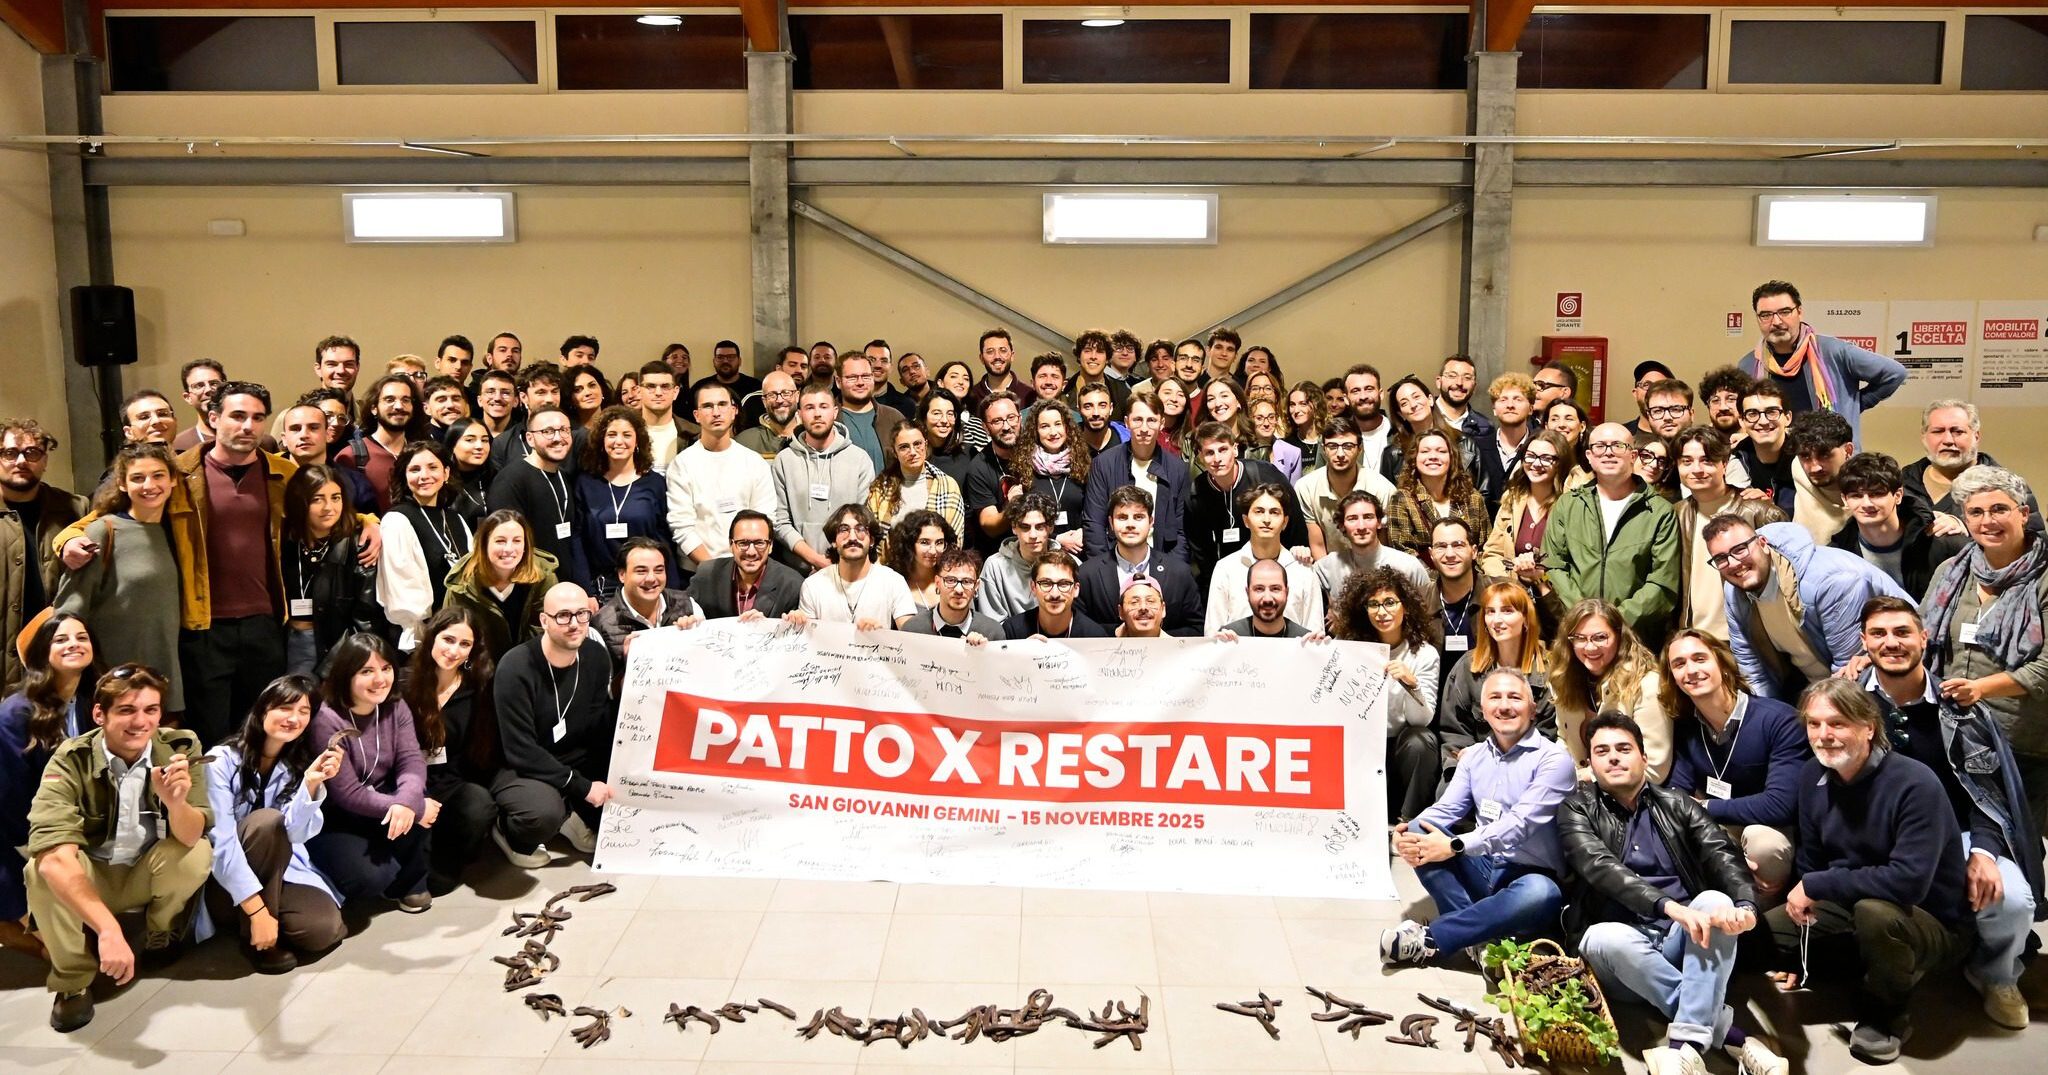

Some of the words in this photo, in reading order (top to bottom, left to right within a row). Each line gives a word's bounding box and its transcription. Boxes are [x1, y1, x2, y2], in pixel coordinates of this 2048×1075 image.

[1913, 333, 1964, 344] SCELTA
[1954, 324, 1965, 332] DI
[1894, 331, 1912, 355] 1
[690, 707, 915, 778] PATTO
[930, 727, 982, 785] X
[998, 731, 1311, 795] RESTARE
[789, 793, 829, 811] SAN
[832, 797, 930, 819] GIOVANNI
[933, 805, 1000, 824] GEMINI
[1021, 810, 1041, 826] 15
[1045, 811, 1154, 828] NOVEMBRE
[1157, 812, 1205, 830] 2025
